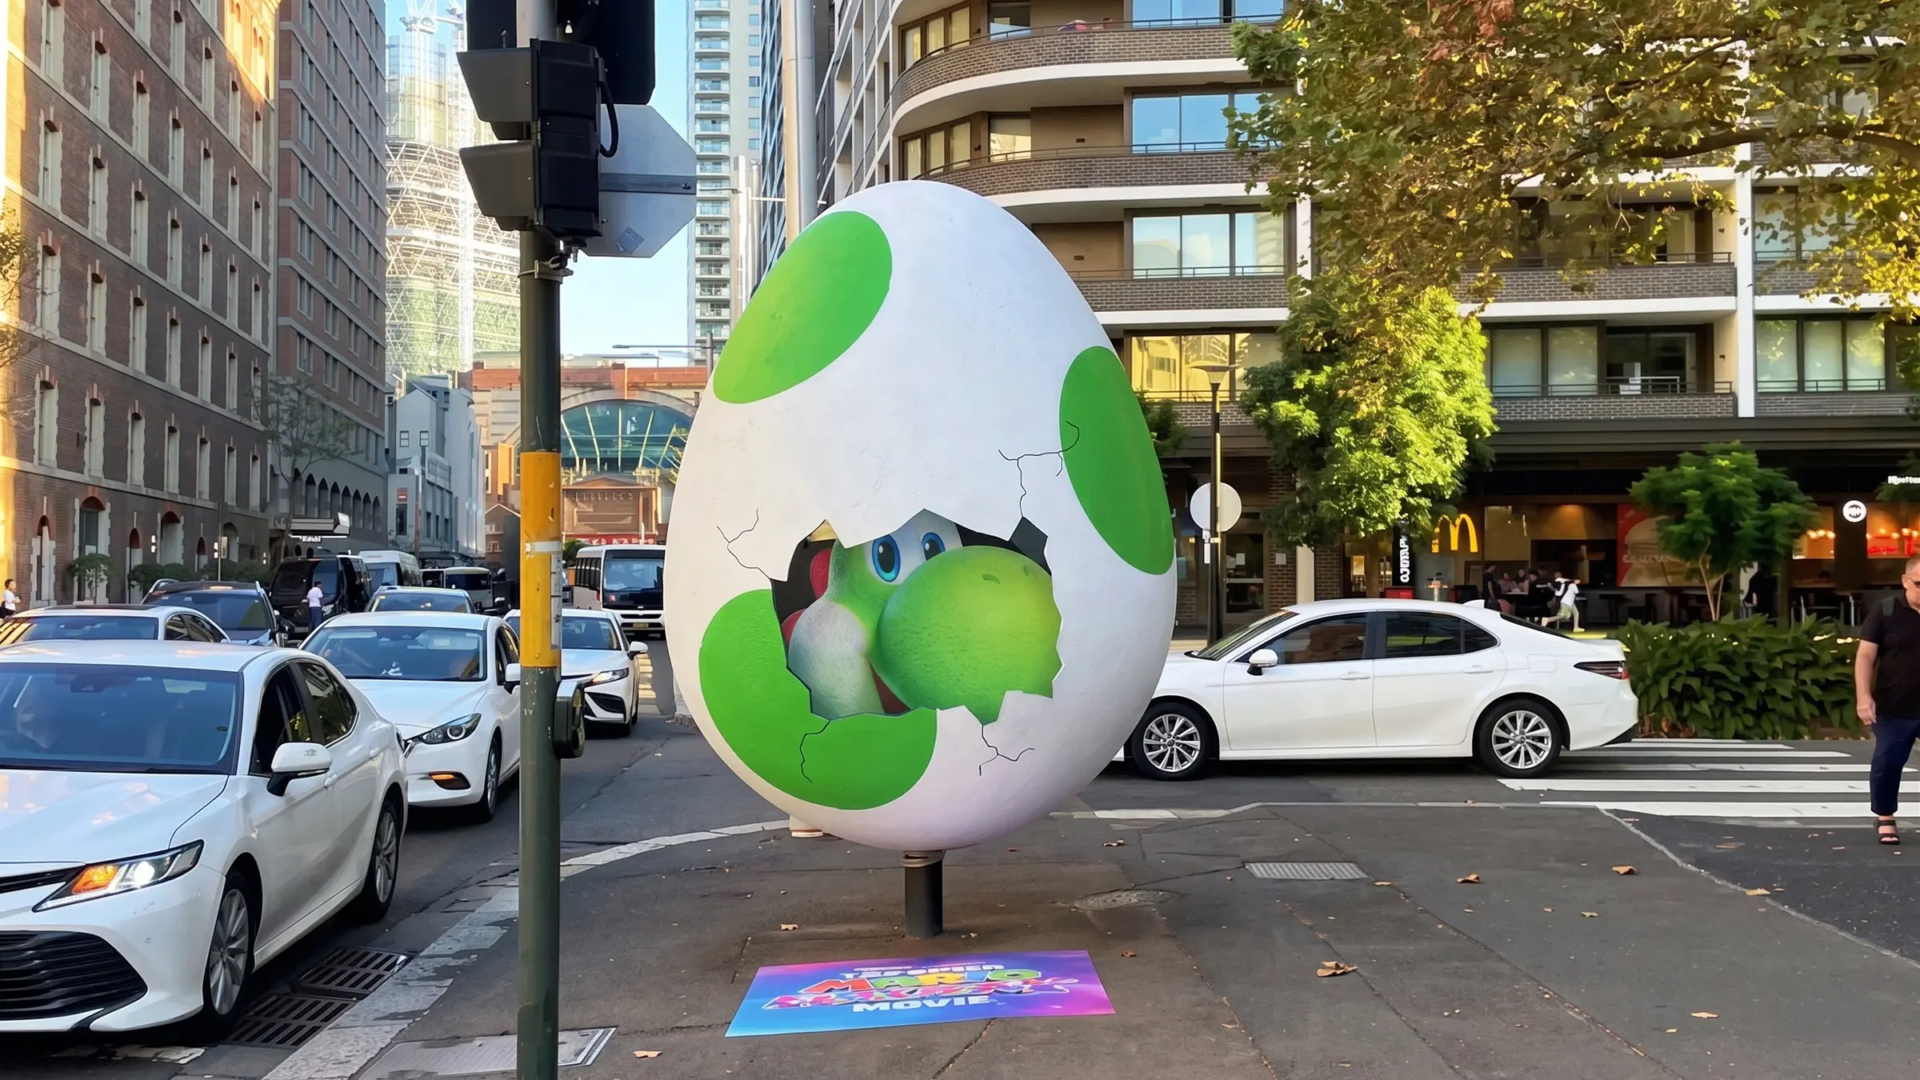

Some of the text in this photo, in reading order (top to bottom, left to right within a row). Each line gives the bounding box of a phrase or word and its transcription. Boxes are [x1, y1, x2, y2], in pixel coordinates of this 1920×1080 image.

[1432, 513, 1478, 553] M
[798, 969, 1042, 993] MARIO
[853, 995, 990, 1012] MOVIE
